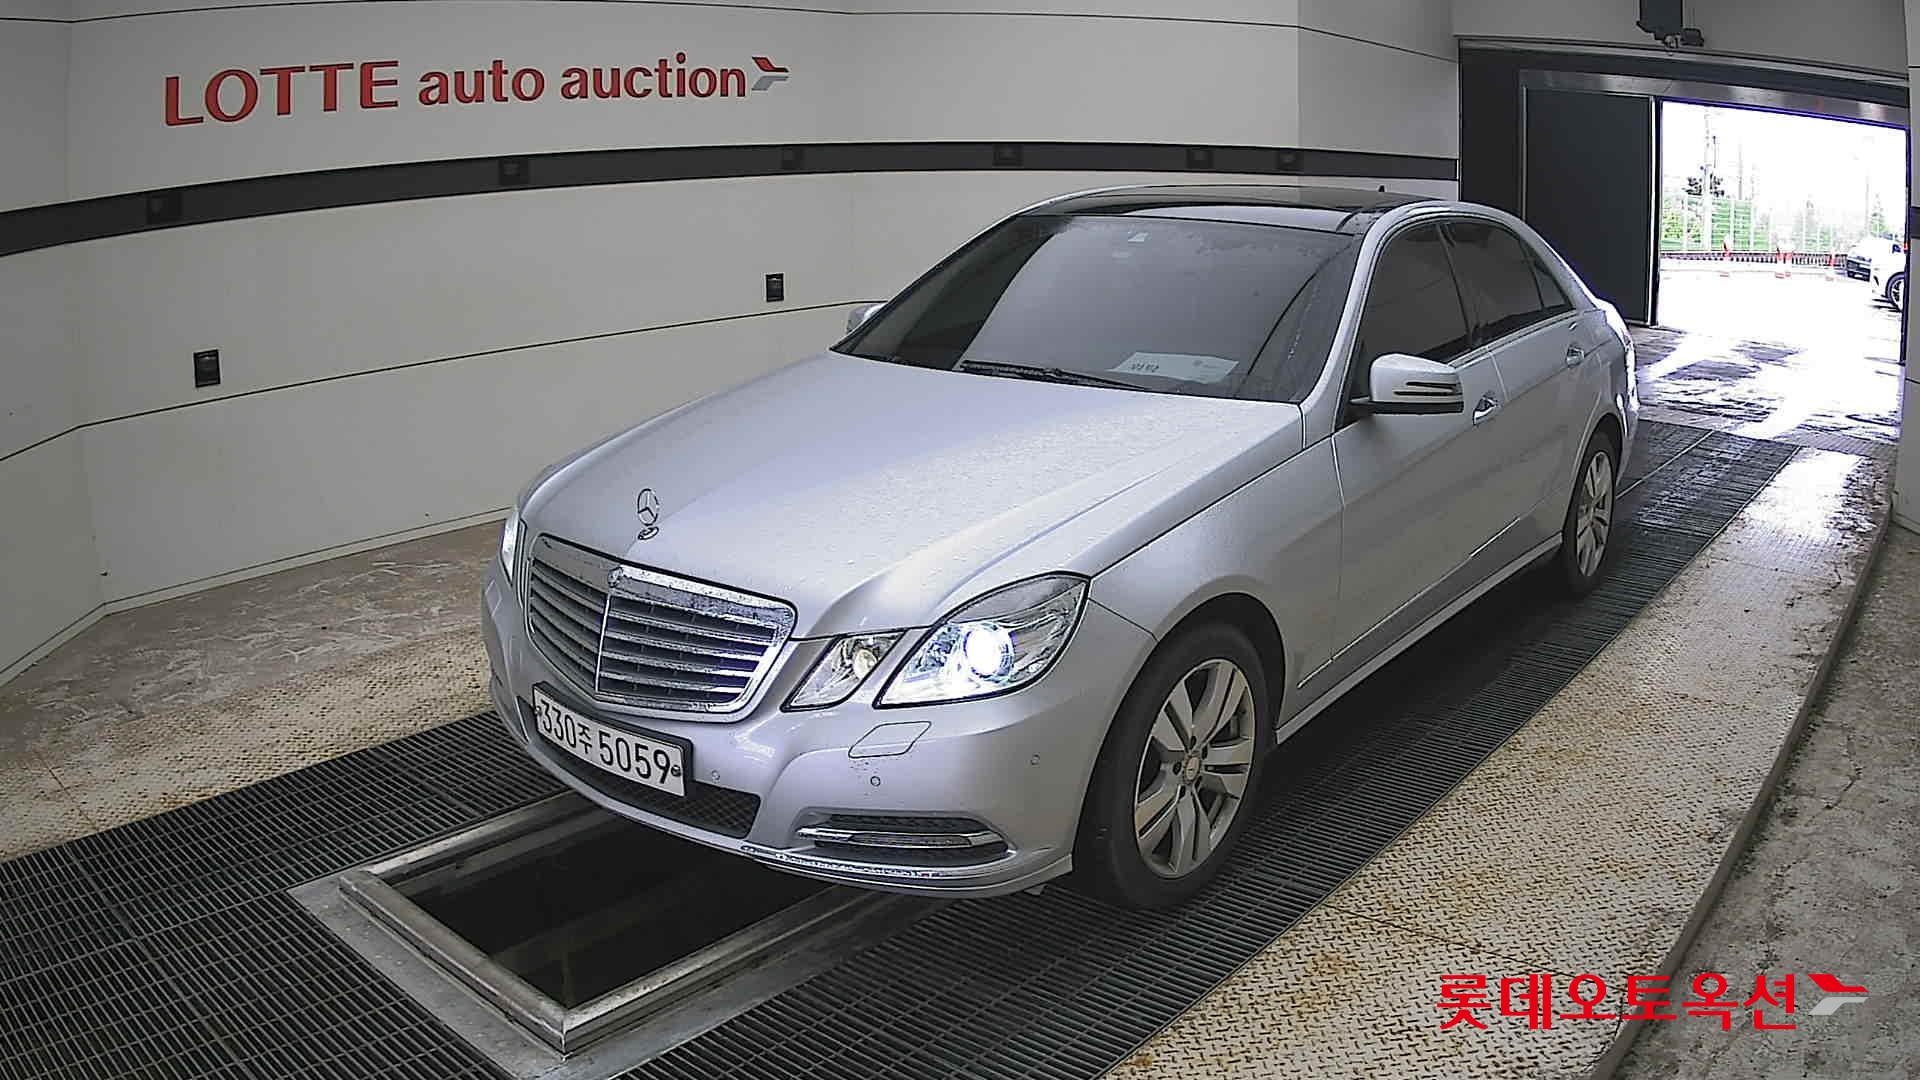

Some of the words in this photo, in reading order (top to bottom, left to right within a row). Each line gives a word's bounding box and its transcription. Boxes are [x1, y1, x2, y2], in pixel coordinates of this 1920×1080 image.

[164, 60, 400, 126] LOTTE
[418, 59, 545, 106] auto
[560, 51, 747, 99] auction
[598, 729, 672, 785] 5059
